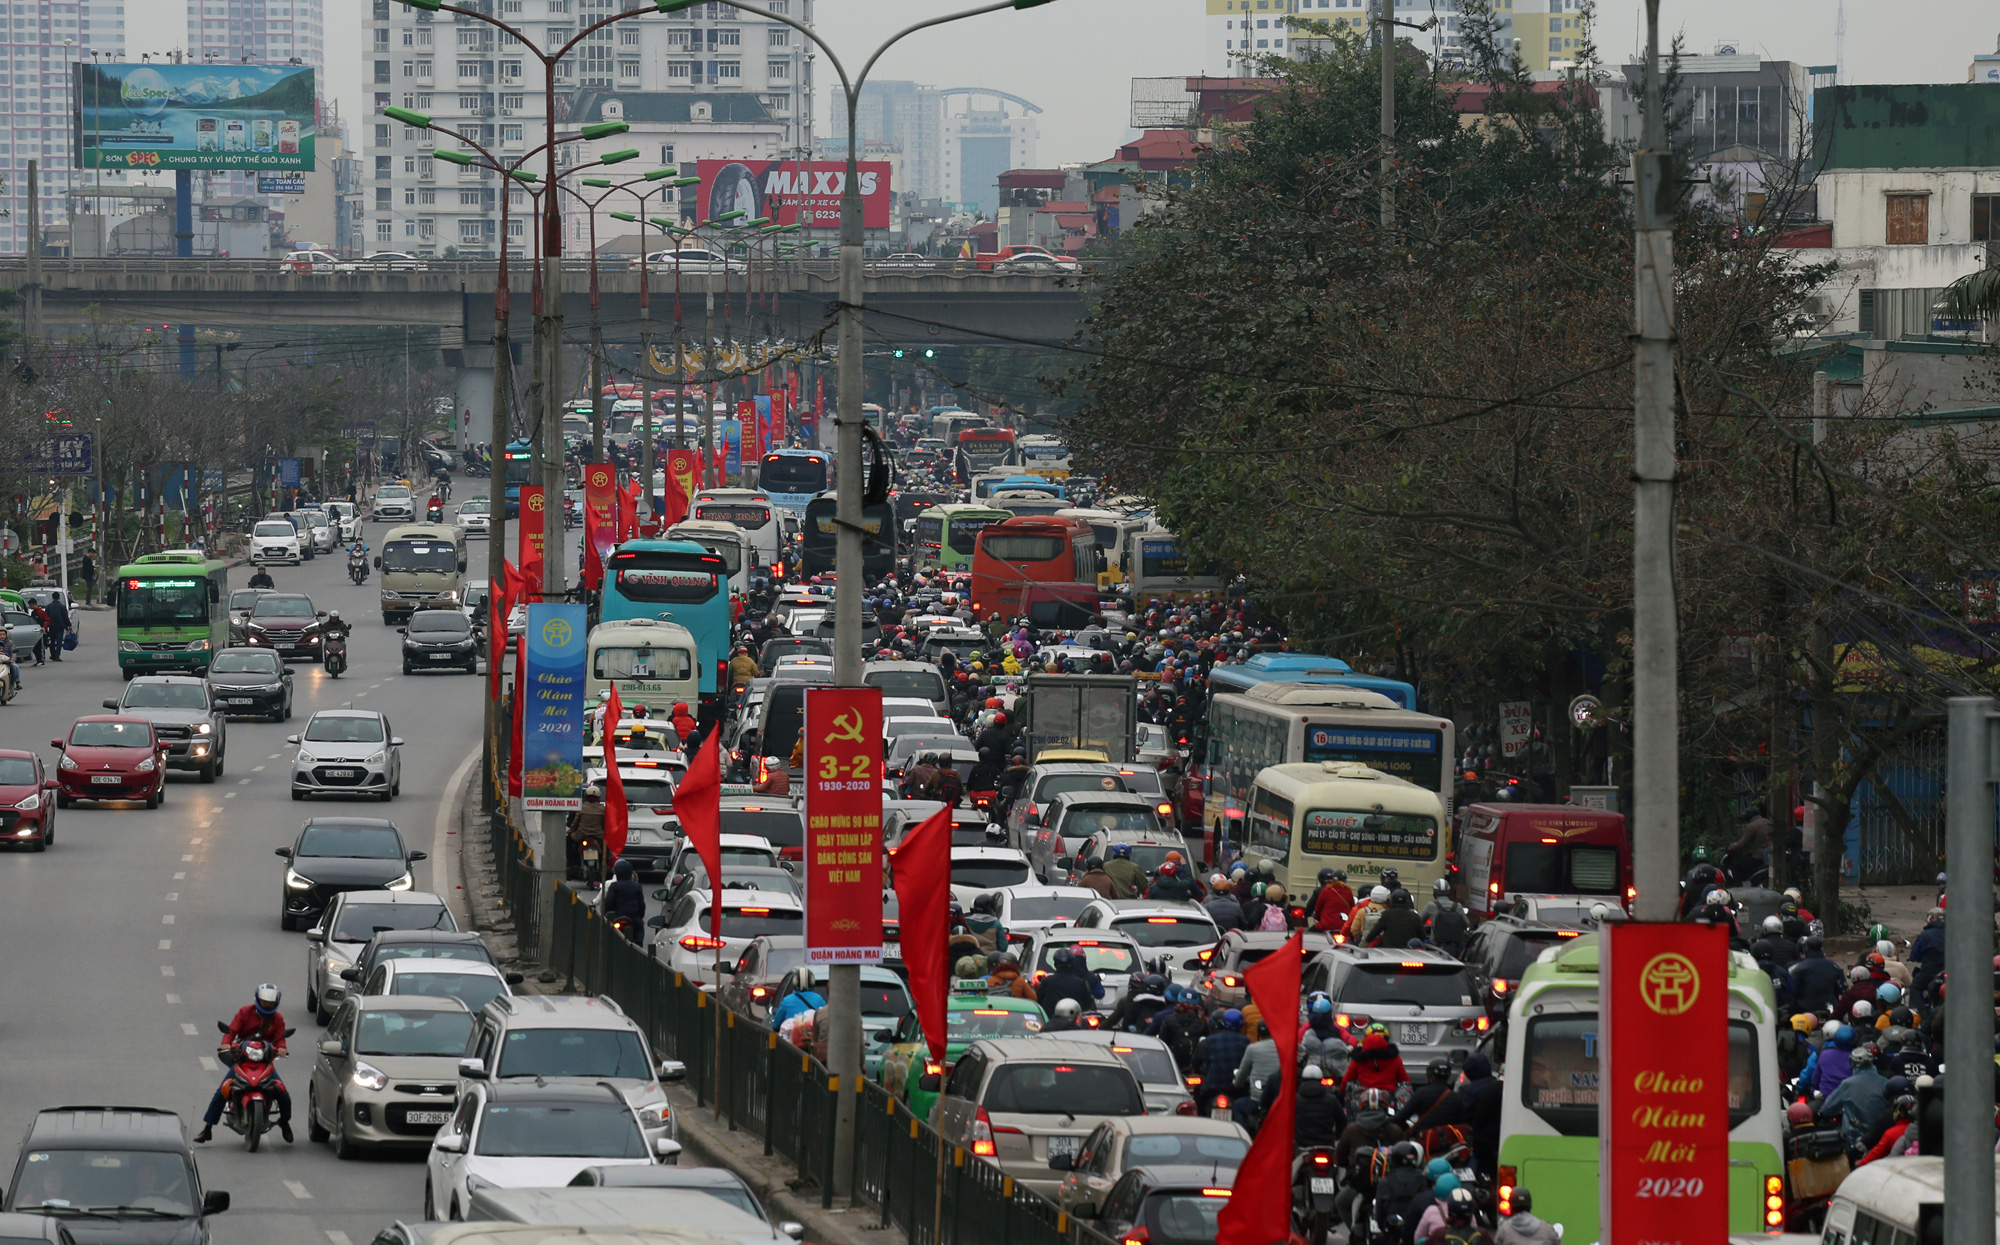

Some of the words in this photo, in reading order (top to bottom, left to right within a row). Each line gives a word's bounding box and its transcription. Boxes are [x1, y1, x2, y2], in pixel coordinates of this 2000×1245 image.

[128, 88, 168, 99] ecoSpec
[130, 152, 156, 164] SPEC
[642, 572, 667, 584] VĨNH
[672, 576, 707, 587] QUANG
[634, 665, 648, 674] 11
[538, 672, 572, 684] Chào
[537, 689, 573, 700] Năm
[540, 705, 568, 717] Mới
[538, 722, 571, 733] 2020
[1511, 725, 1527, 735] XE
[1316, 734, 1326, 743] 16
[819, 755, 870, 779] 3-2
[818, 781, 870, 791] 1930-2020
[527, 798, 543, 808] QUẬN
[810, 814, 829, 828] CHÀO
[830, 814, 851, 828] MỪNG
[852, 816, 862, 828] 90
[863, 813, 879, 827] NĂM
[1336, 816, 1358, 828] VIỆT
[816, 832, 834, 846] NGÀY
[836, 832, 859, 846] THÀNH
[860, 832, 873, 848] LẬP
[817, 849, 836, 865] ĐẢNG
[838, 850, 856, 866] CỘNG
[858, 849, 872, 864] SẢN
[828, 868, 844, 885] VIỆT
[845, 870, 861, 882] NAM
[811, 949, 833, 961] QUẬN
[835, 948, 862, 959] HOÀNG
[864, 950, 879, 959] MAI
[1408, 1024, 1421, 1032] 30E
[1633, 1070, 1704, 1094] Chào
[1631, 1105, 1706, 1129] Năm
[1056, 1137, 1072, 1147] 30A
[1639, 1140, 1697, 1163] Mới
[1635, 1177, 1704, 1198] 2020
